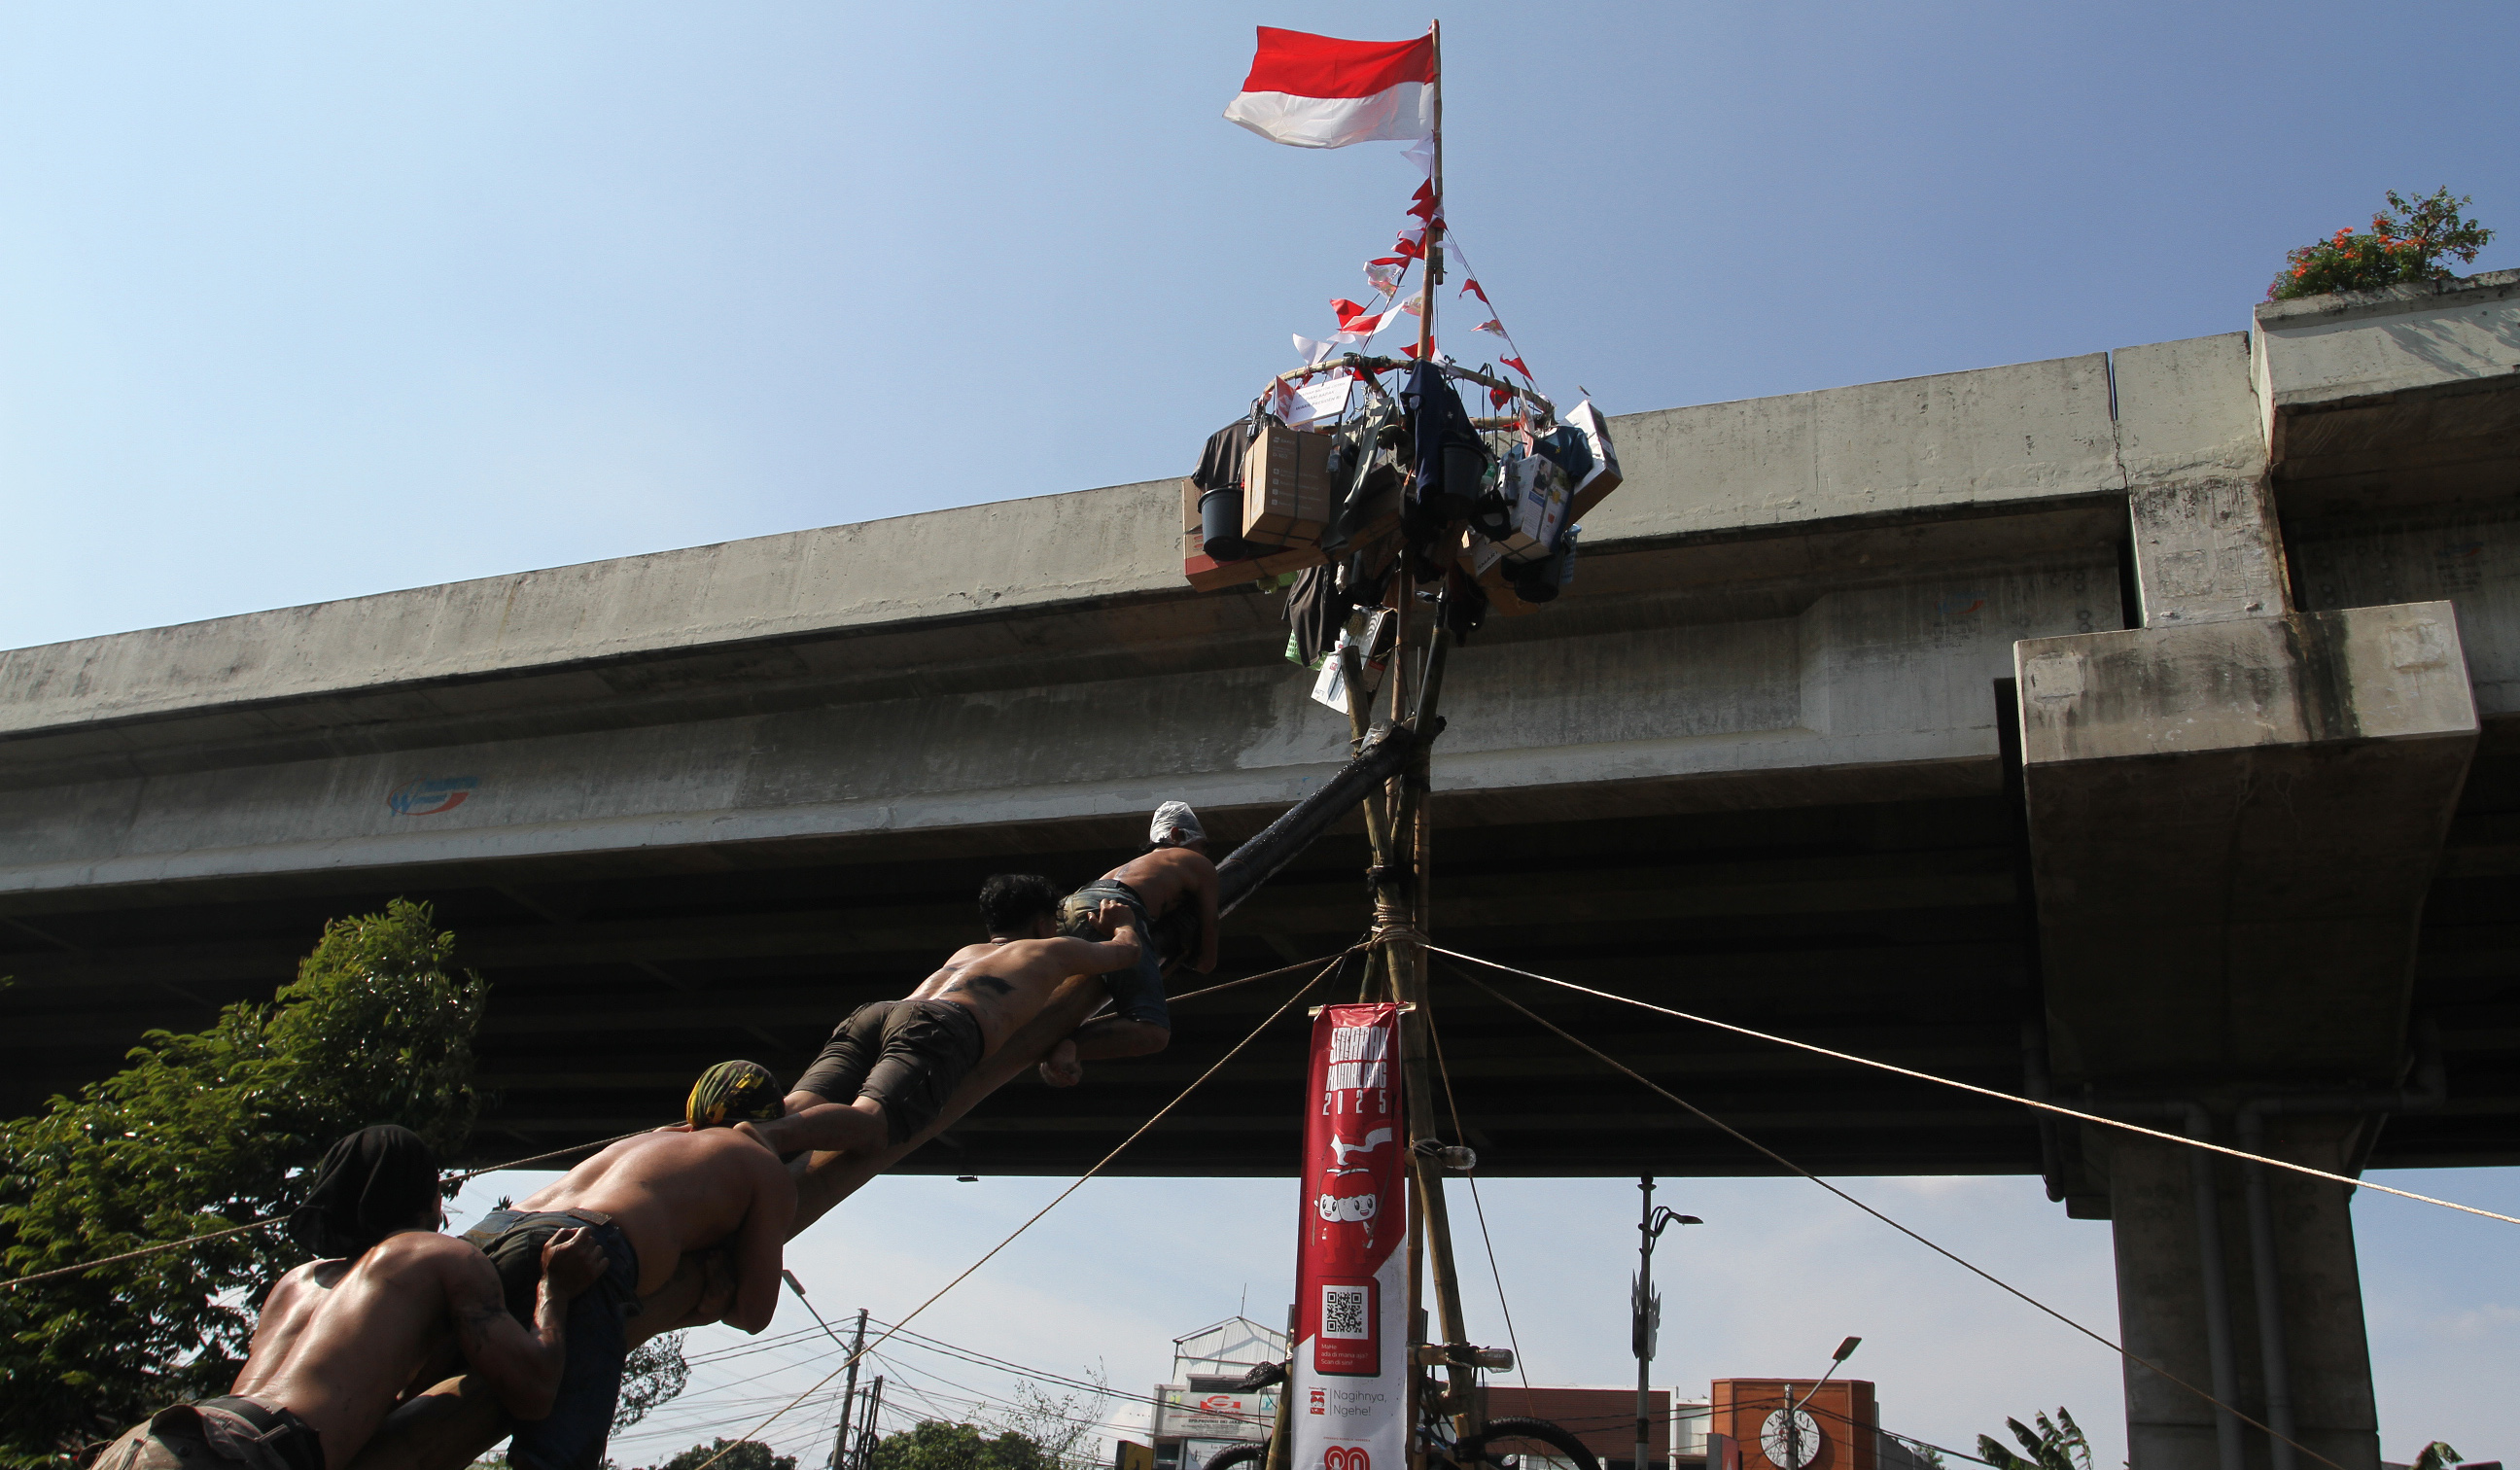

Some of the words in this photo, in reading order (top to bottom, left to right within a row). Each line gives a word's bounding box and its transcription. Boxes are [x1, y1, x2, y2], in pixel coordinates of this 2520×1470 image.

[1322, 1090, 1386, 1115] 2025
[1333, 1389, 1387, 1404] Nagihnya,
[1333, 1405, 1372, 1418] Ngehe!
